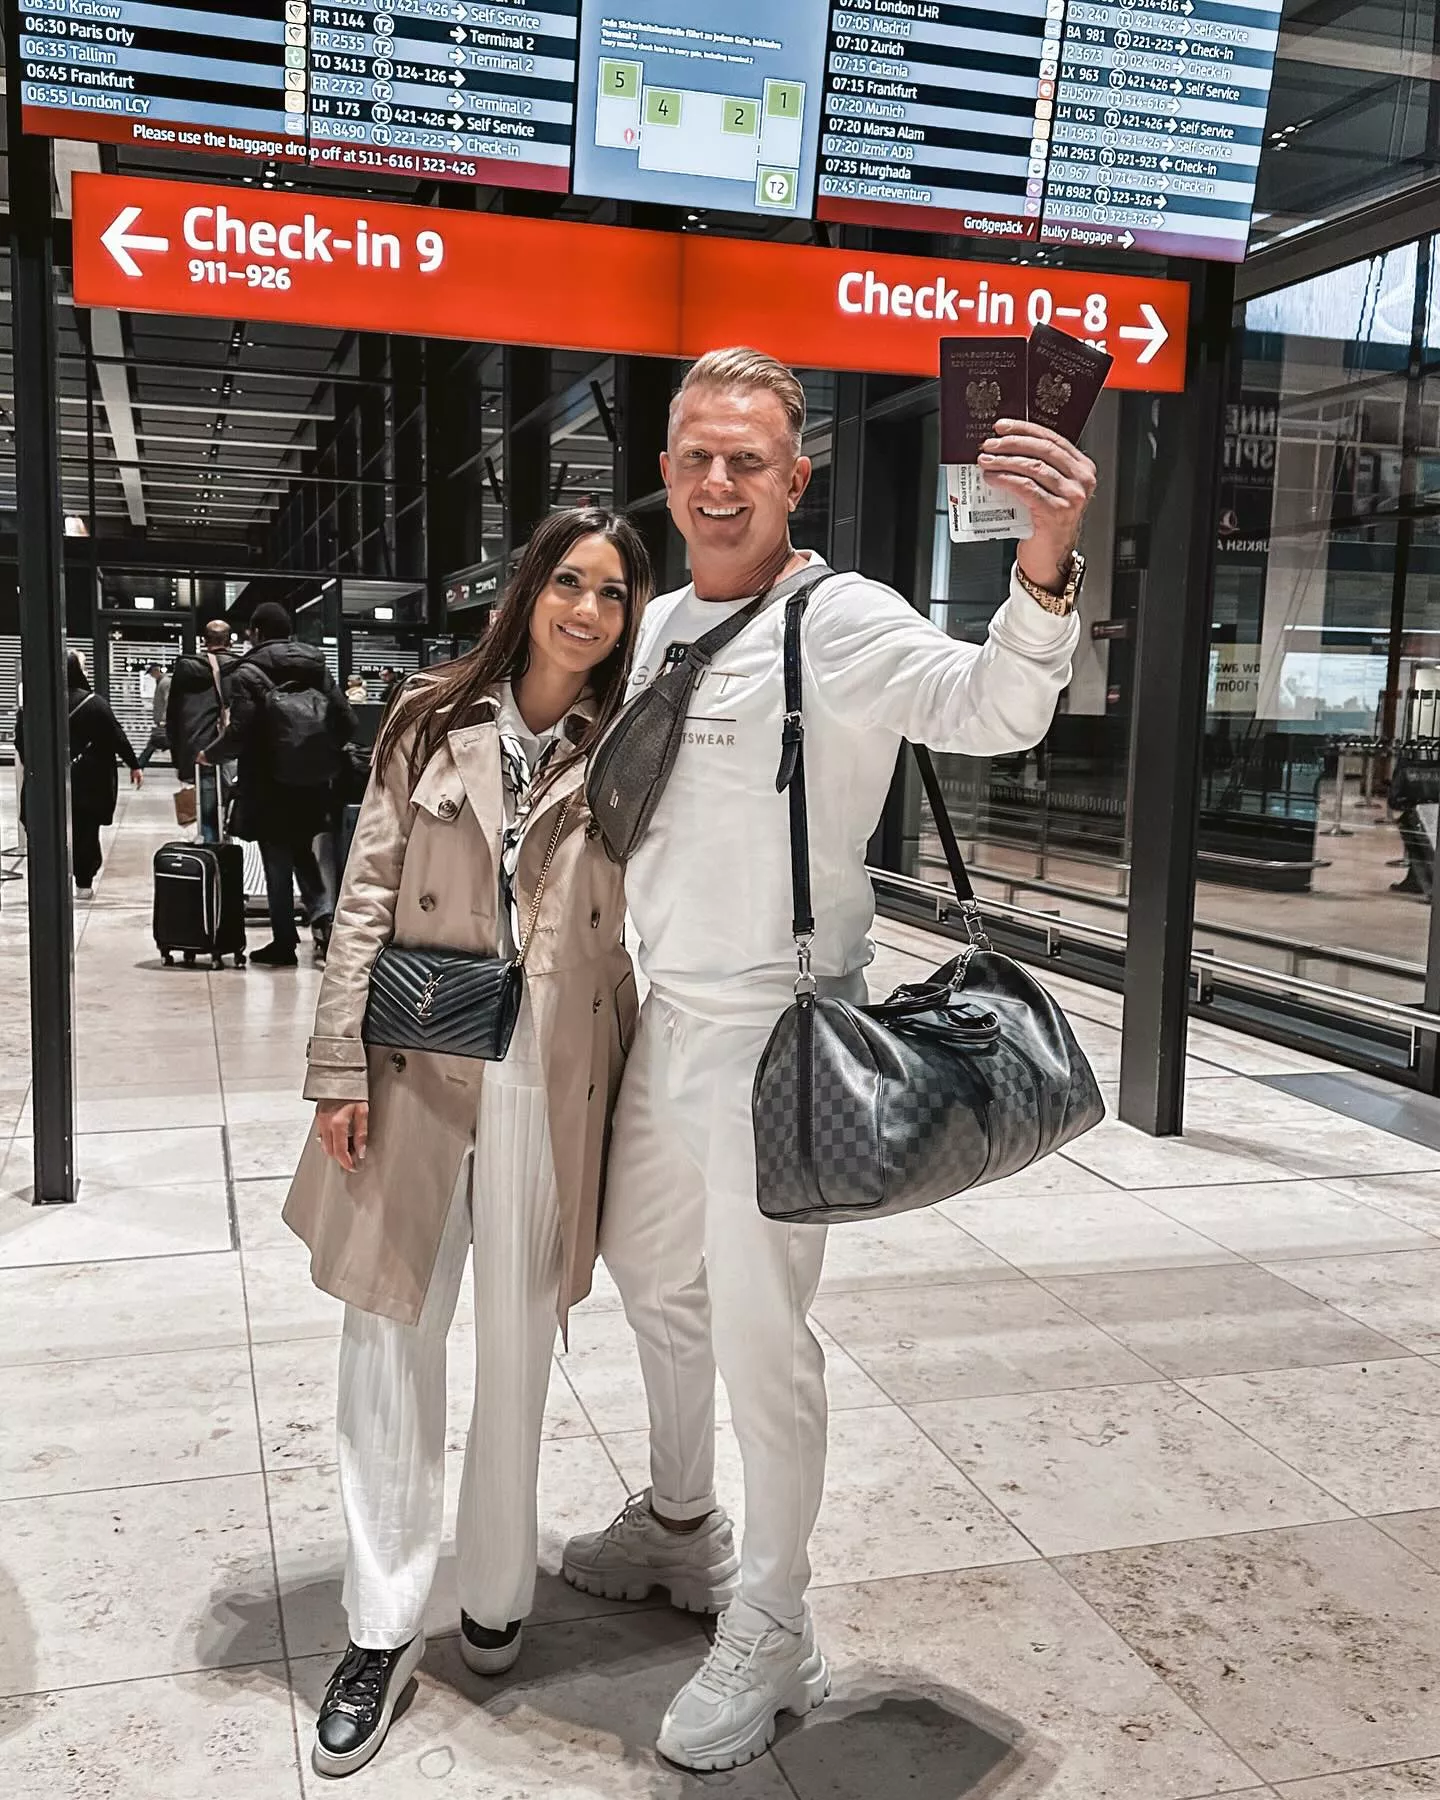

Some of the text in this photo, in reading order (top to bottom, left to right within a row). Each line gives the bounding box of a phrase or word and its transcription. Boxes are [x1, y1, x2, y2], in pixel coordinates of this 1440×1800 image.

[69, 0, 121, 19] Krakow
[396, 0, 541, 30] 421-426 Self Service
[874, 0, 915, 16] London
[917, 4, 940, 19] LHR
[25, 16, 135, 47] 06:30 Paris Orly
[313, 8, 330, 24] FR
[332, 12, 366, 29] 1144
[469, 28, 524, 50] Terminal
[525, 37, 535, 51] 2
[837, 14, 912, 36] 07:05 Madrid
[1088, 7, 1109, 22] 240
[1135, 15, 1177, 32] 421-426
[1193, 23, 1214, 37] Self
[1214, 26, 1249, 42] Service
[25, 39, 117, 65] 06:35 Tallinn
[312, 31, 330, 46] FR
[331, 34, 366, 51] 2535
[468, 51, 523, 71] Terminal
[524, 59, 534, 73] 2
[835, 35, 905, 57] 07:10 Zurich
[1066, 25, 1082, 39] BA
[1086, 28, 1106, 43] 981
[1132, 35, 1174, 52] 221-225
[1190, 43, 1234, 60] Check-in
[26, 63, 135, 90] 06:45 Frankfurt
[311, 53, 331, 69] TO
[333, 56, 366, 74] 3413
[396, 65, 447, 84] 124-126
[834, 56, 909, 78] 07:15 Catania
[1076, 47, 1104, 62] 3673
[1188, 62, 1231, 80] Check-in
[614, 71, 625, 88] 5
[832, 77, 918, 100] 07:15 Frankfurt
[1061, 65, 1076, 79] LX
[1079, 67, 1100, 82] 963
[1127, 74, 1169, 92] 421-426
[1184, 82, 1206, 96] Self
[1205, 84, 1241, 101] Service
[27, 86, 150, 114] 06:55 London LCY
[312, 76, 329, 91] FR
[331, 79, 365, 96] 2732
[467, 95, 521, 115] Terminal
[523, 102, 532, 116] 2
[779, 91, 788, 109] 1
[1059, 85, 1104, 102] EJU5077
[312, 98, 330, 113] LH
[336, 101, 361, 117] 173
[394, 108, 446, 127] 421-426
[466, 116, 491, 133] Self
[492, 120, 536, 138] Service
[657, 99, 669, 116] 4
[734, 108, 745, 125] 2
[830, 97, 905, 118] 07:20 Munich
[829, 118, 925, 141] 07:20 Marsa Alam
[1056, 105, 1071, 119] LH
[1075, 107, 1096, 122] 045
[1122, 114, 1164, 131] 421-426
[1179, 120, 1200, 134] Self
[1200, 122, 1235, 139] Service
[133, 124, 175, 142] Please
[178, 133, 201, 145] use
[203, 132, 226, 148] the
[228, 134, 283, 157] baggage
[321, 146, 342, 161] off
[343, 149, 357, 163] at
[358, 151, 414, 169] 511-616
[422, 157, 477, 177] 323-426
[312, 120, 331, 135] BA
[332, 123, 366, 139] 8490
[394, 130, 445, 148] 221-225
[466, 138, 520, 157] Check-in
[827, 138, 914, 160] 07:20 Izmir ADB
[1054, 125, 1069, 138] LH
[1071, 127, 1097, 141] 1963
[1119, 133, 1161, 149] 421-426
[1176, 140, 1198, 155] Self
[1198, 143, 1233, 158] Service
[825, 158, 912, 180] 07:35 Hurghada
[1051, 144, 1069, 158] SM
[1070, 147, 1097, 161] 2963
[1116, 152, 1158, 168] 921-923
[1174, 159, 1218, 176] Check-in
[769, 180, 785, 195] T2
[823, 179, 932, 202] 07:45 Fuerteventura
[1049, 164, 1215, 195] XQ 967 714-716 Check-in
[1047, 183, 1065, 196] EW
[1065, 185, 1092, 200] 8982
[1112, 191, 1153, 207] 323-326
[1045, 202, 1062, 216] EW
[1063, 204, 1090, 219] 8180
[1109, 210, 1150, 225] 323-326
[182, 204, 444, 273] Check-in 9
[963, 216, 1113, 245] Großgepäck Bulky Baggage
[837, 270, 1015, 326] Check-in
